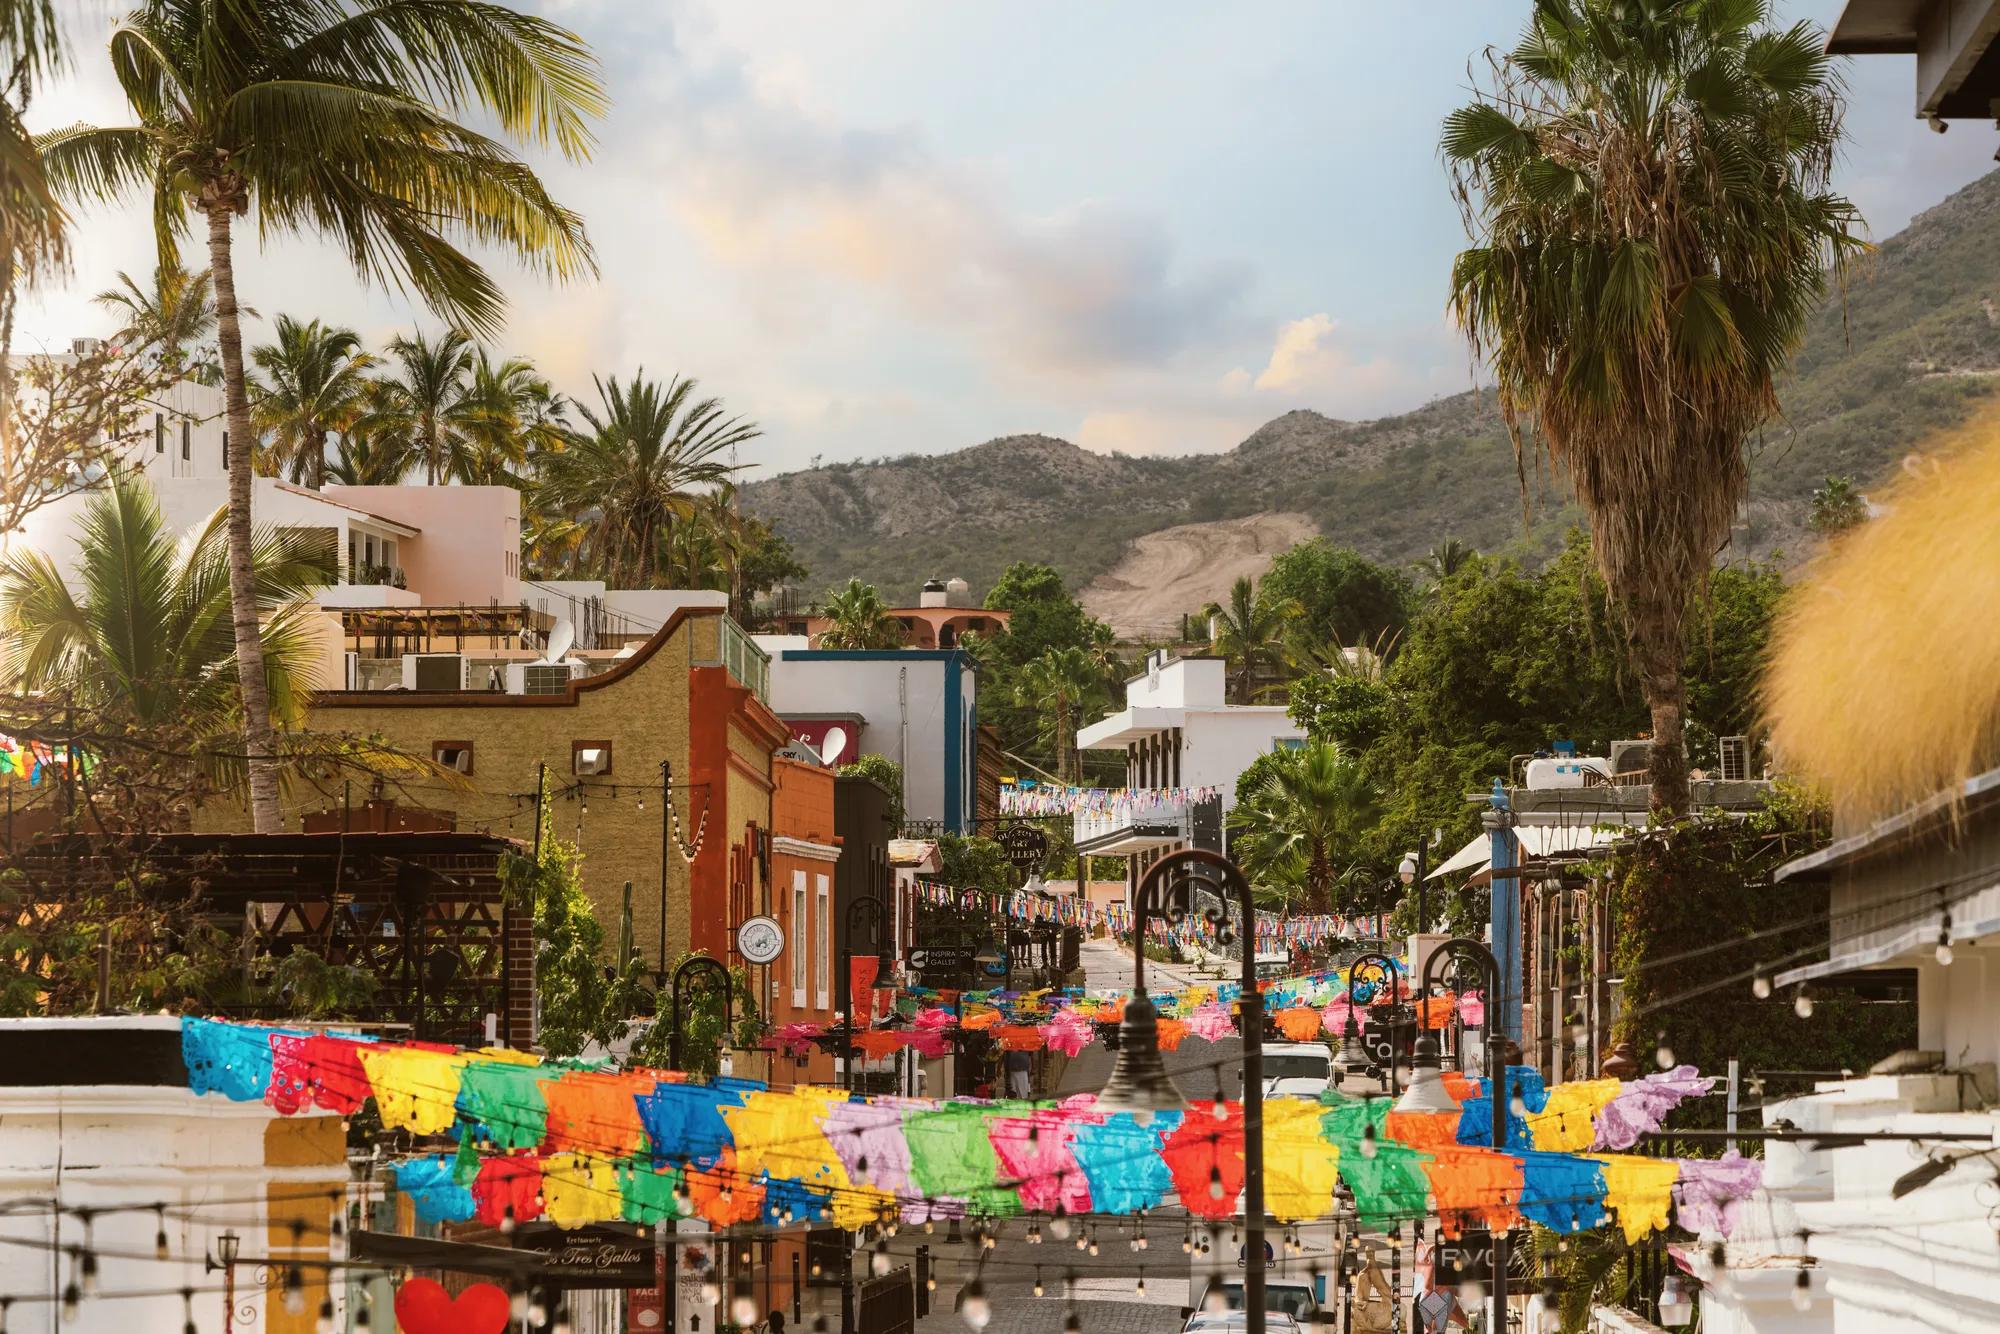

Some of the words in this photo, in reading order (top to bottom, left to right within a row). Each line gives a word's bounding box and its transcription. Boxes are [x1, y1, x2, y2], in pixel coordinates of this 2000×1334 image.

[997, 848, 1043, 859] GLLERY
[561, 1246, 593, 1265] Tres
[595, 1244, 641, 1269] Gallos
[635, 1288, 660, 1297] FACE
